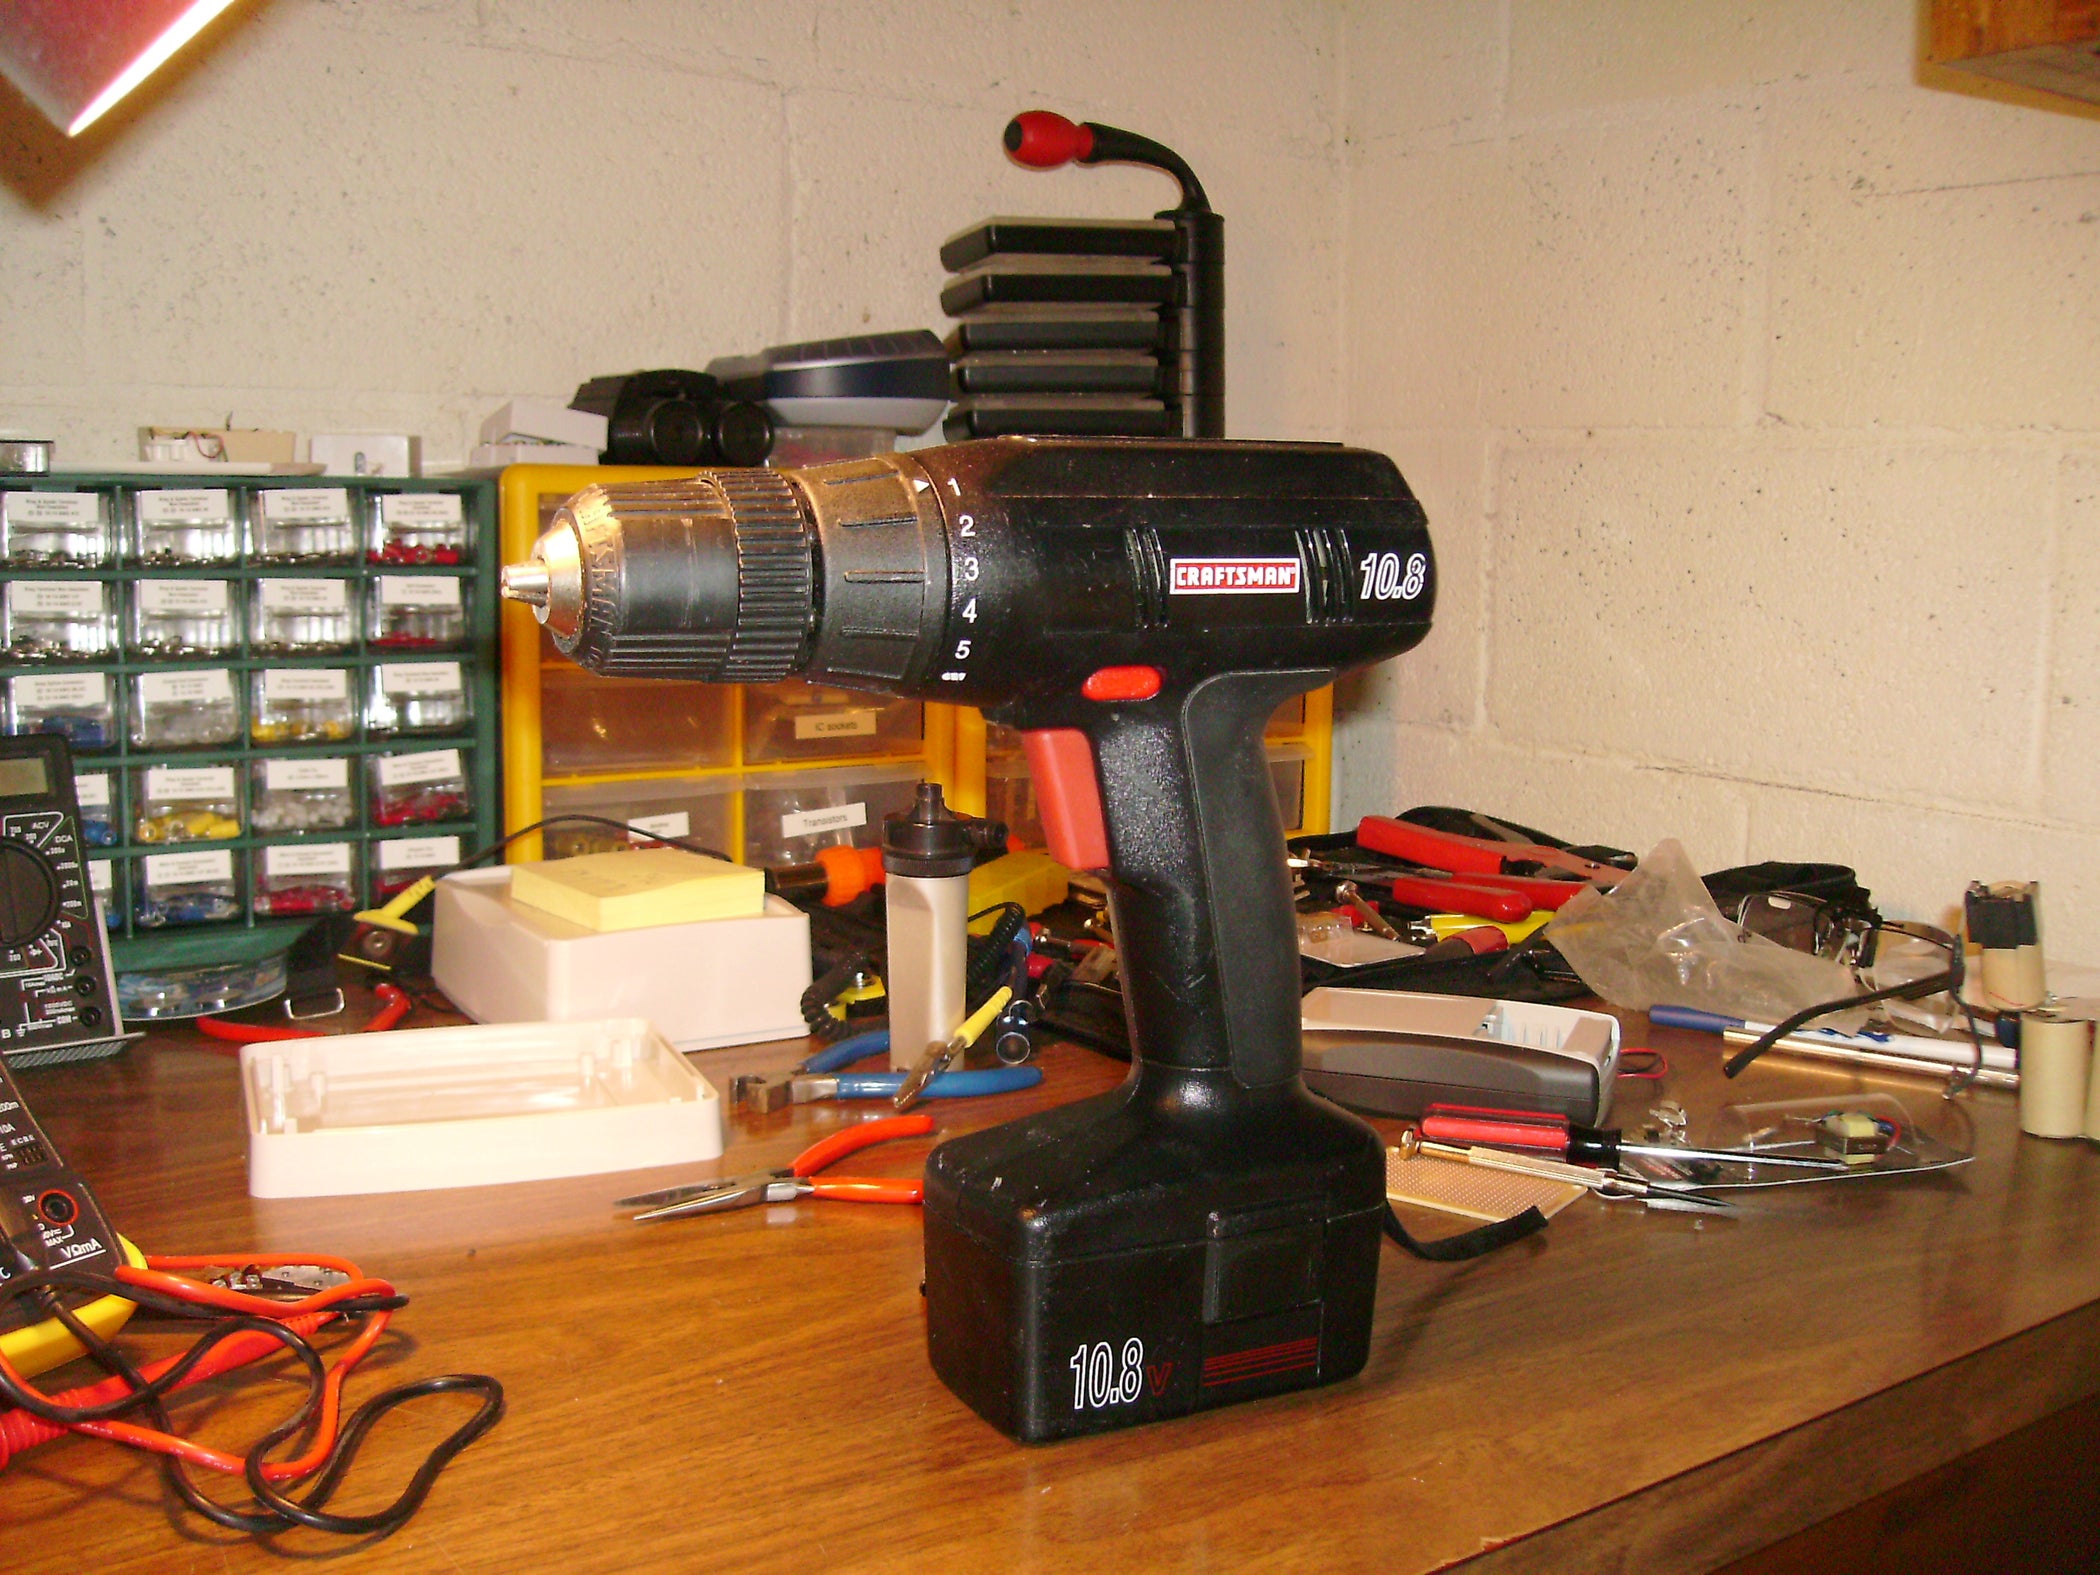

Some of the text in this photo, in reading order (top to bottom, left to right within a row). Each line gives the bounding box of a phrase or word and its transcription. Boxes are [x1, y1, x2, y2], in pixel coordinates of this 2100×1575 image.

[947, 477, 961, 496] 1
[959, 515, 976, 537] 2
[965, 558, 979, 581] 3
[1176, 566, 1292, 587] CRAFTSMAN
[1360, 552, 1426, 601] 10.8
[962, 598, 978, 623] 4
[955, 640, 971, 659] 5
[827, 721, 858, 731] sockets
[32, 821, 50, 829] ACV
[1070, 1337, 1144, 1411] 10.8
